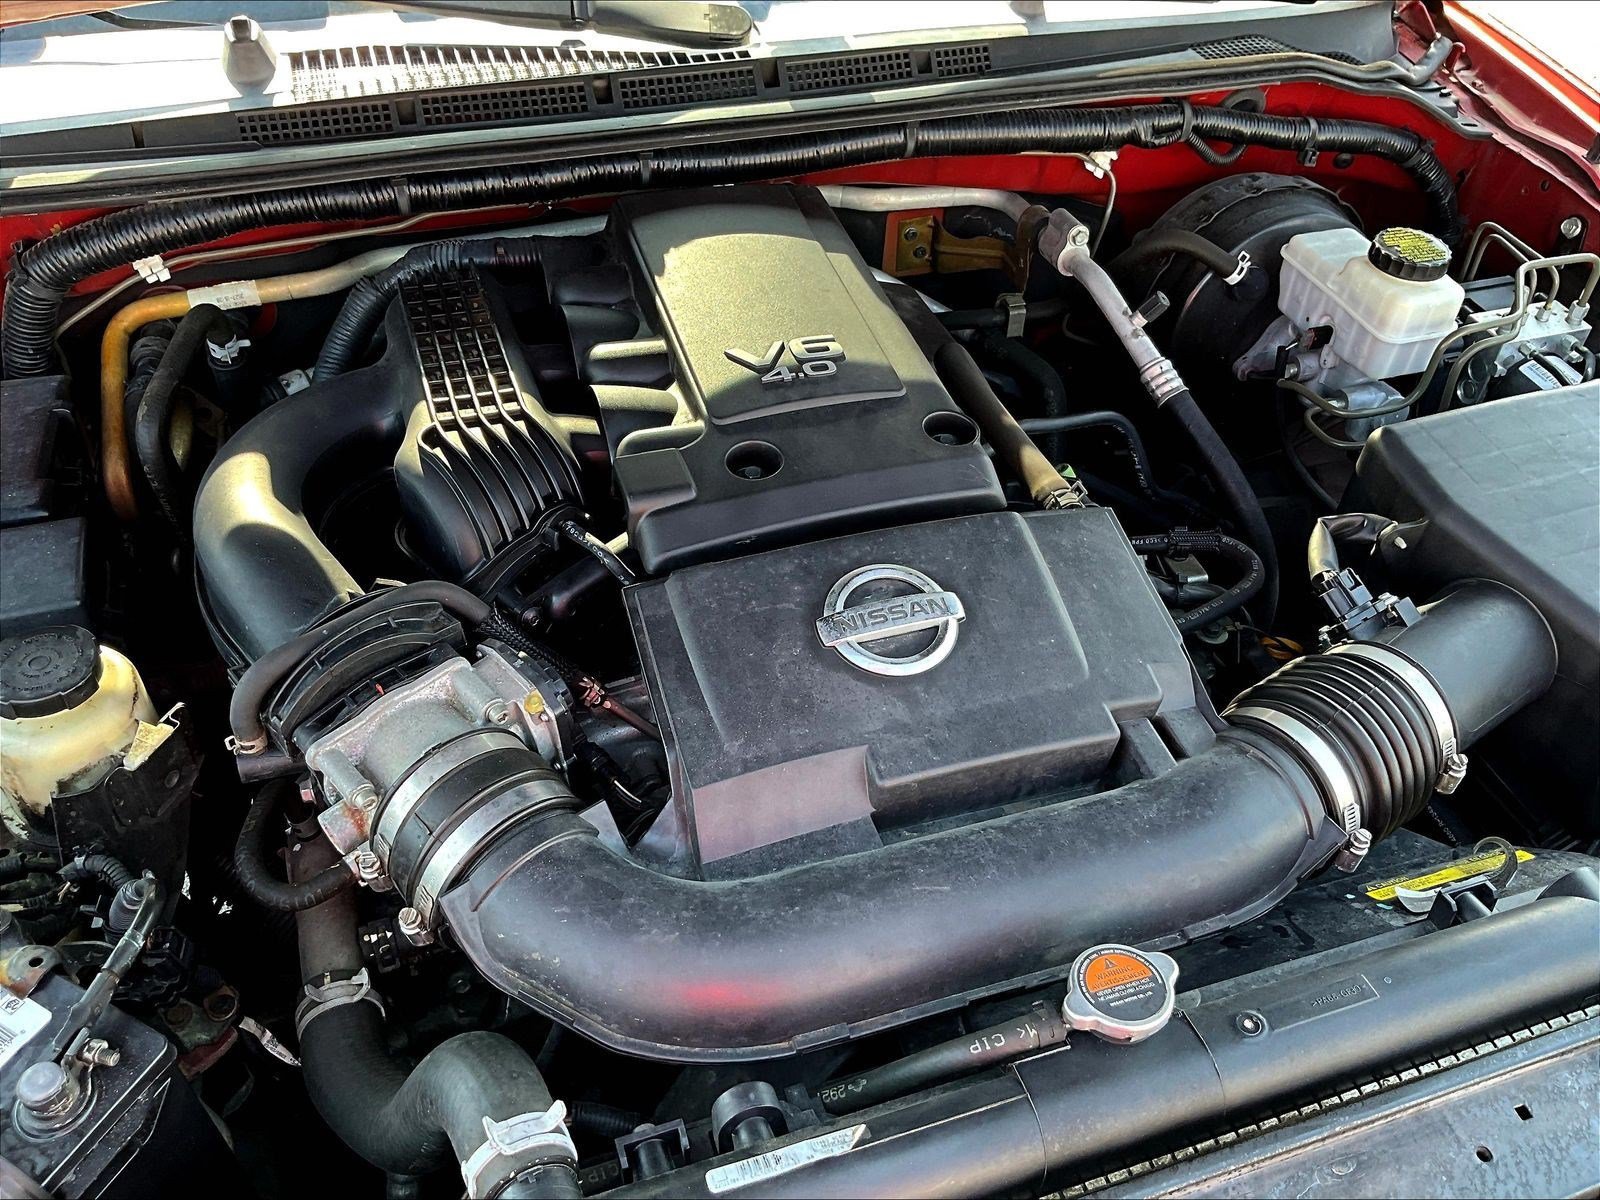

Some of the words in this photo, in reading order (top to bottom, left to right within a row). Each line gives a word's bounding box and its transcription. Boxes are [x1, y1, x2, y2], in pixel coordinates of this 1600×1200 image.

[724, 334, 846, 374] V6
[761, 360, 837, 384] 4.0
[833, 597, 949, 634] NISSAN
[1092, 969, 1147, 990] AVERTISSEMENT
[1095, 966, 1134, 981] WARNING
[1096, 988, 1112, 997] NEVER
[1112, 984, 1125, 993] OPEN
[1125, 980, 1140, 990] WHEN
[969, 1033, 1005, 1053] CIP
